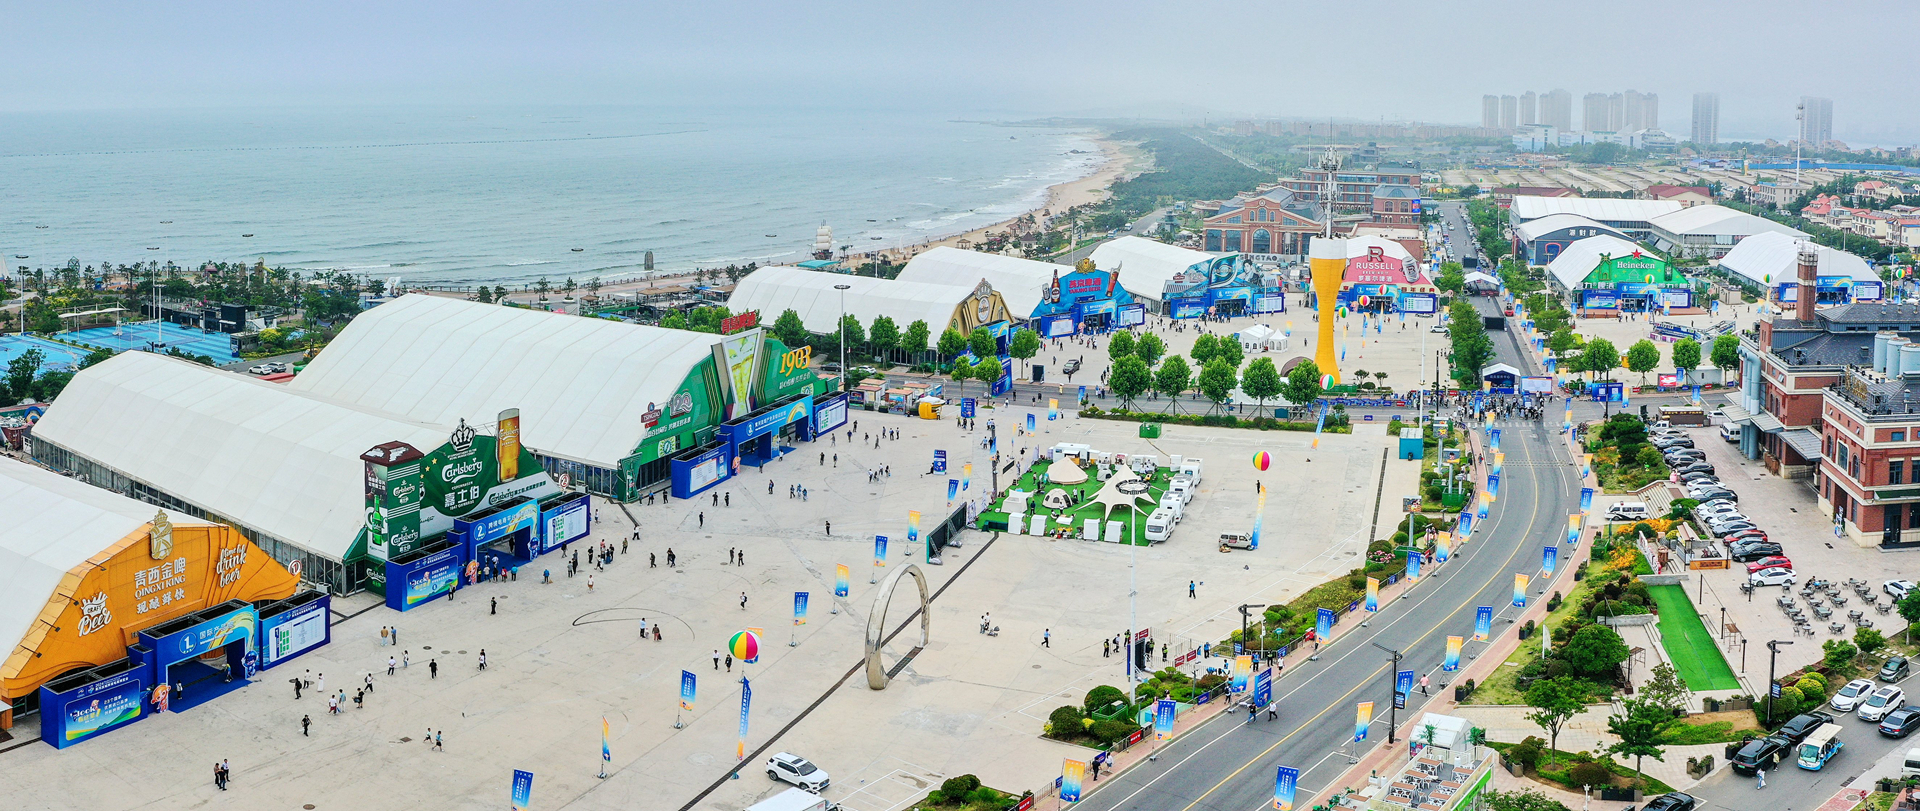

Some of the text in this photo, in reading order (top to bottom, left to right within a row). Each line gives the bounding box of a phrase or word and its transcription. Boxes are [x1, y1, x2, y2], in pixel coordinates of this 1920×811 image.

[1367, 245, 1384, 262] R
[1356, 262, 1395, 270] RUSSELL
[1617, 261, 1655, 269] Heineken
[779, 345, 812, 377] 1903
[643, 411, 660, 421] TSINGTAO
[442, 458, 482, 483] Carlsberg
[393, 483, 416, 498] Carlsberg
[444, 486, 480, 508] 嘉士伯
[488, 488, 514, 505] Carlsberg
[391, 529, 419, 546] Carlsberg
[216, 552, 247, 574] drink
[134, 557, 186, 589] 青西金啤
[220, 567, 241, 588] beer
[366, 568, 387, 584] Carlsberg
[134, 575, 186, 601] QINGXI KING
[87, 604, 102, 613] CRAFT
[78, 608, 113, 637] Beer
